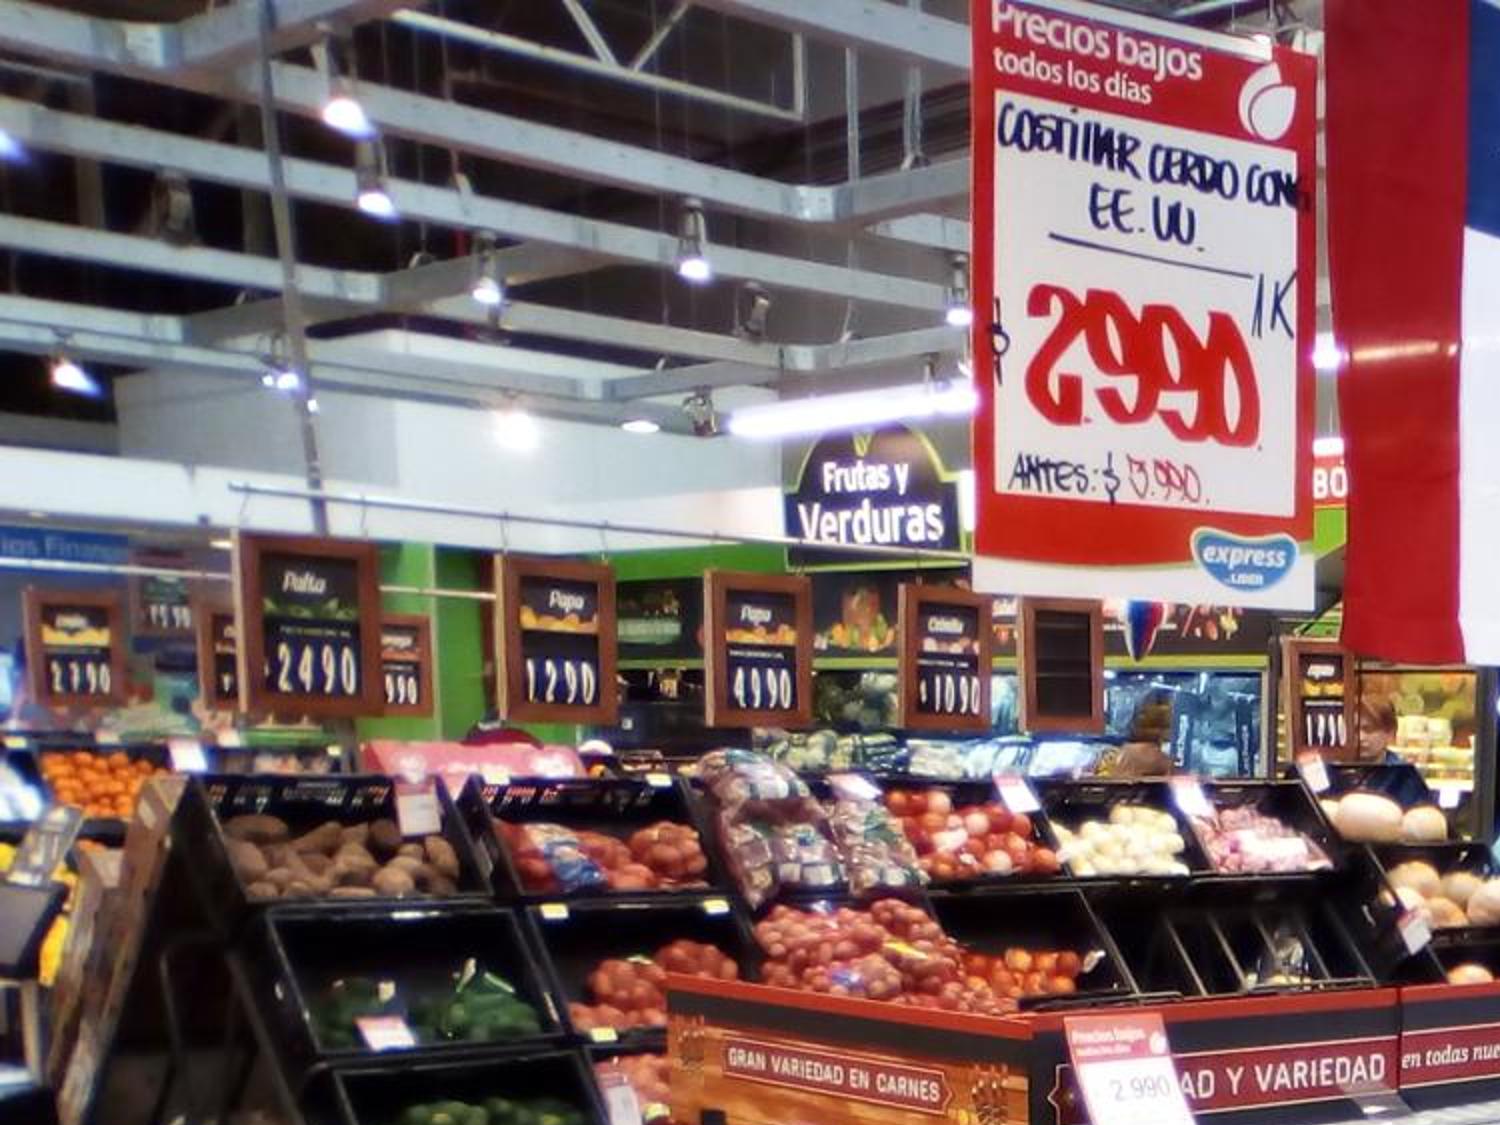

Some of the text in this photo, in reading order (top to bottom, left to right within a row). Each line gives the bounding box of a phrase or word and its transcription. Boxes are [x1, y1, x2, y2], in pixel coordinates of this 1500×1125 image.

[992, 2, 1203, 82] Precios bajos
[994, 46, 1152, 106] todos los días
[1149, 144, 1240, 202] CERDO
[822, 460, 910, 496] Frutas y
[797, 497, 945, 545] Verduras
[1203, 543, 1288, 573] express
[526, 658, 596, 705] 1290
[728, 1047, 941, 1102] GRAN VARIEDAD EN CARNES
[1227, 1066, 1244, 1094] Y
[1254, 1053, 1386, 1092] VARIEDAD
[1401, 1053, 1422, 1069] en
[1426, 1042, 1470, 1066] todas
